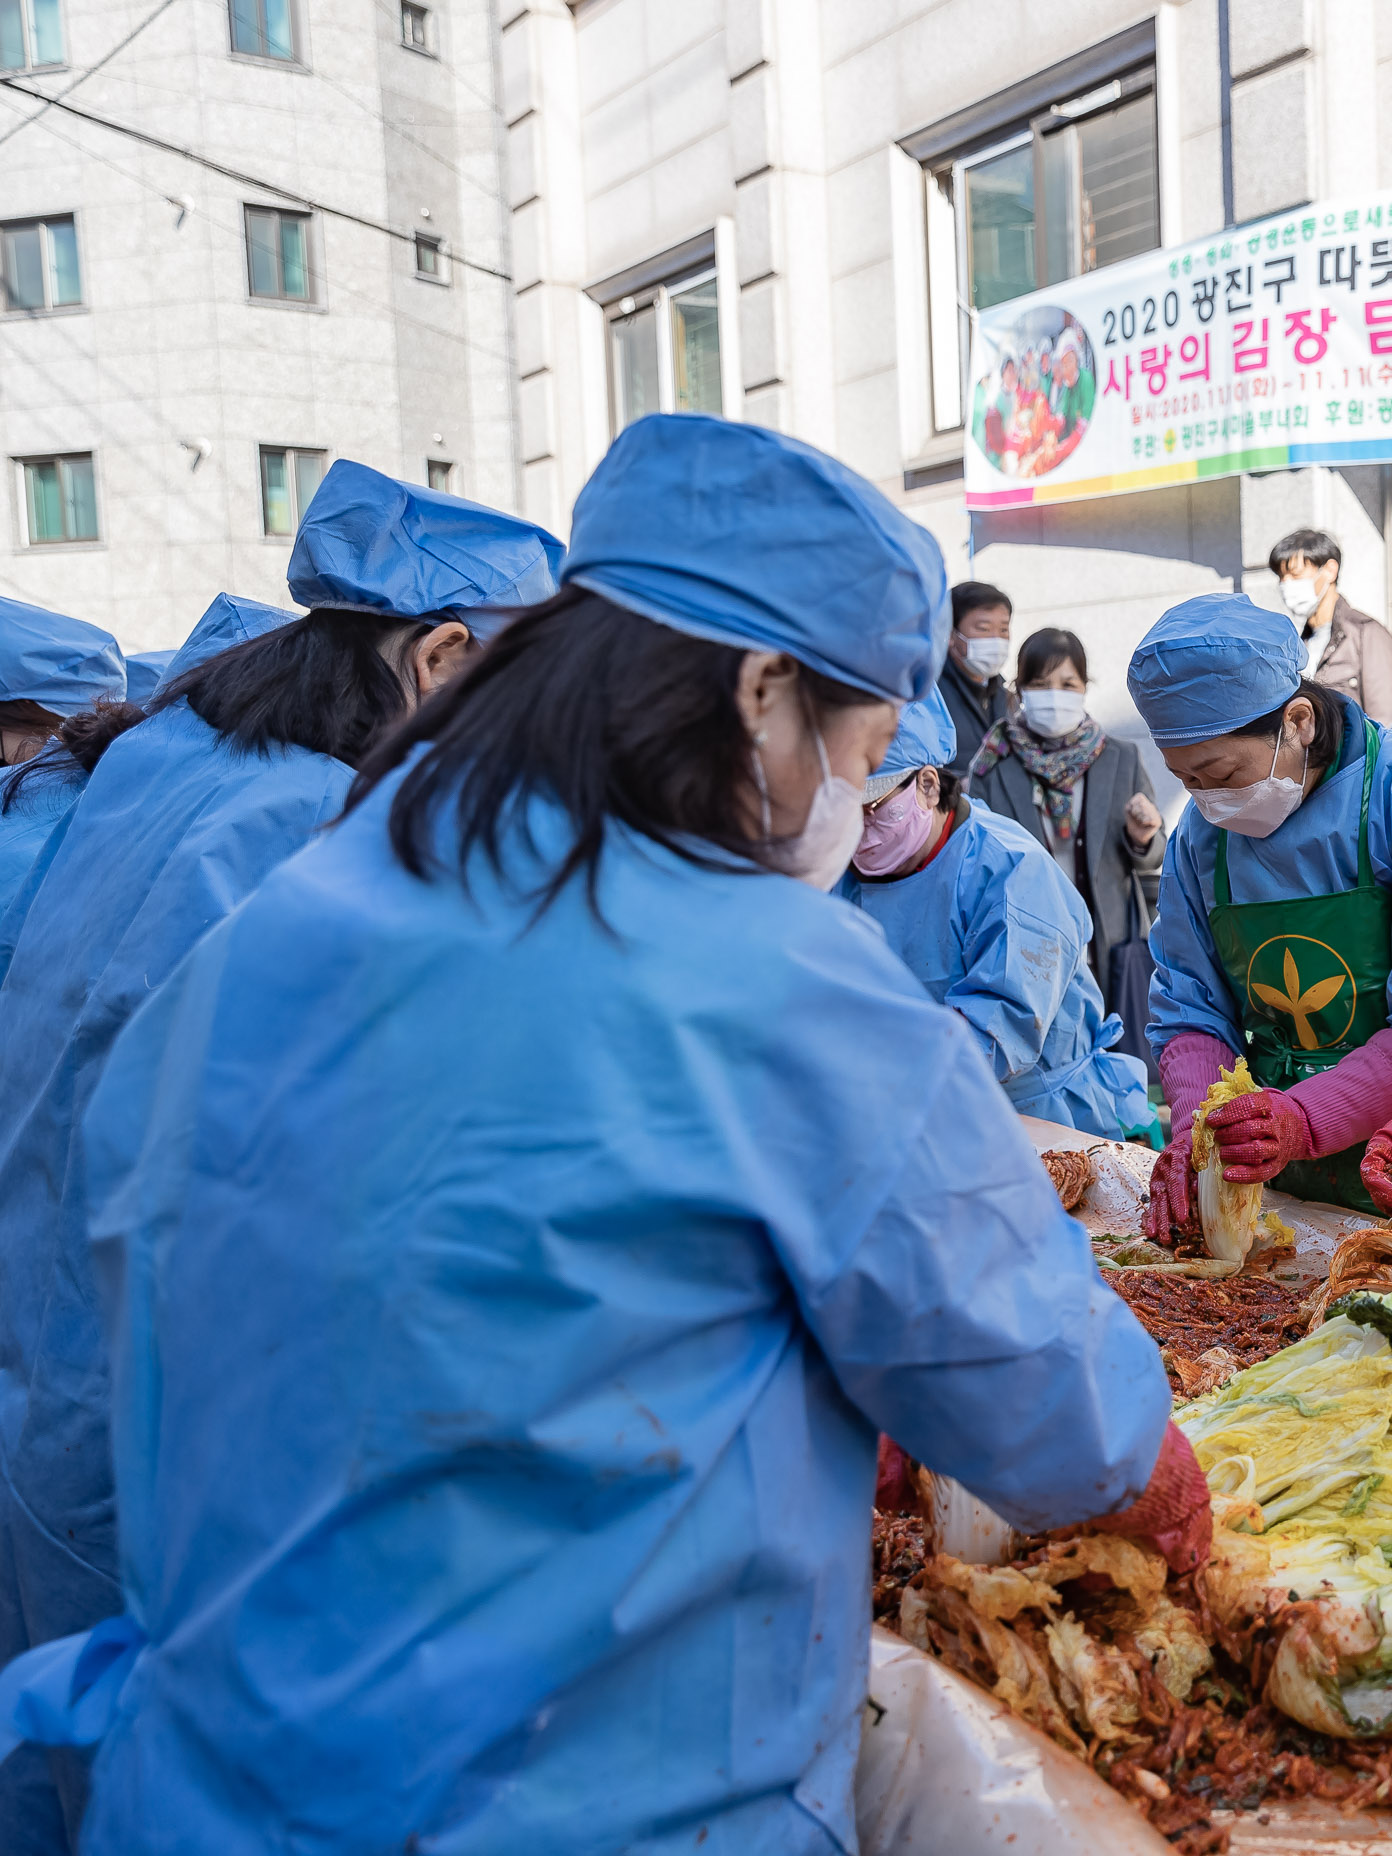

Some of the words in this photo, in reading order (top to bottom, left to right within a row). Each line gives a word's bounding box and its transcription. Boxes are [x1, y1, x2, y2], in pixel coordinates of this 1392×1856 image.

[1102, 290, 1180, 348] 2020
[1190, 253, 1297, 323] 광진구
[1102, 331, 1212, 402] 사랑의
[1232, 305, 1338, 374] 김장
